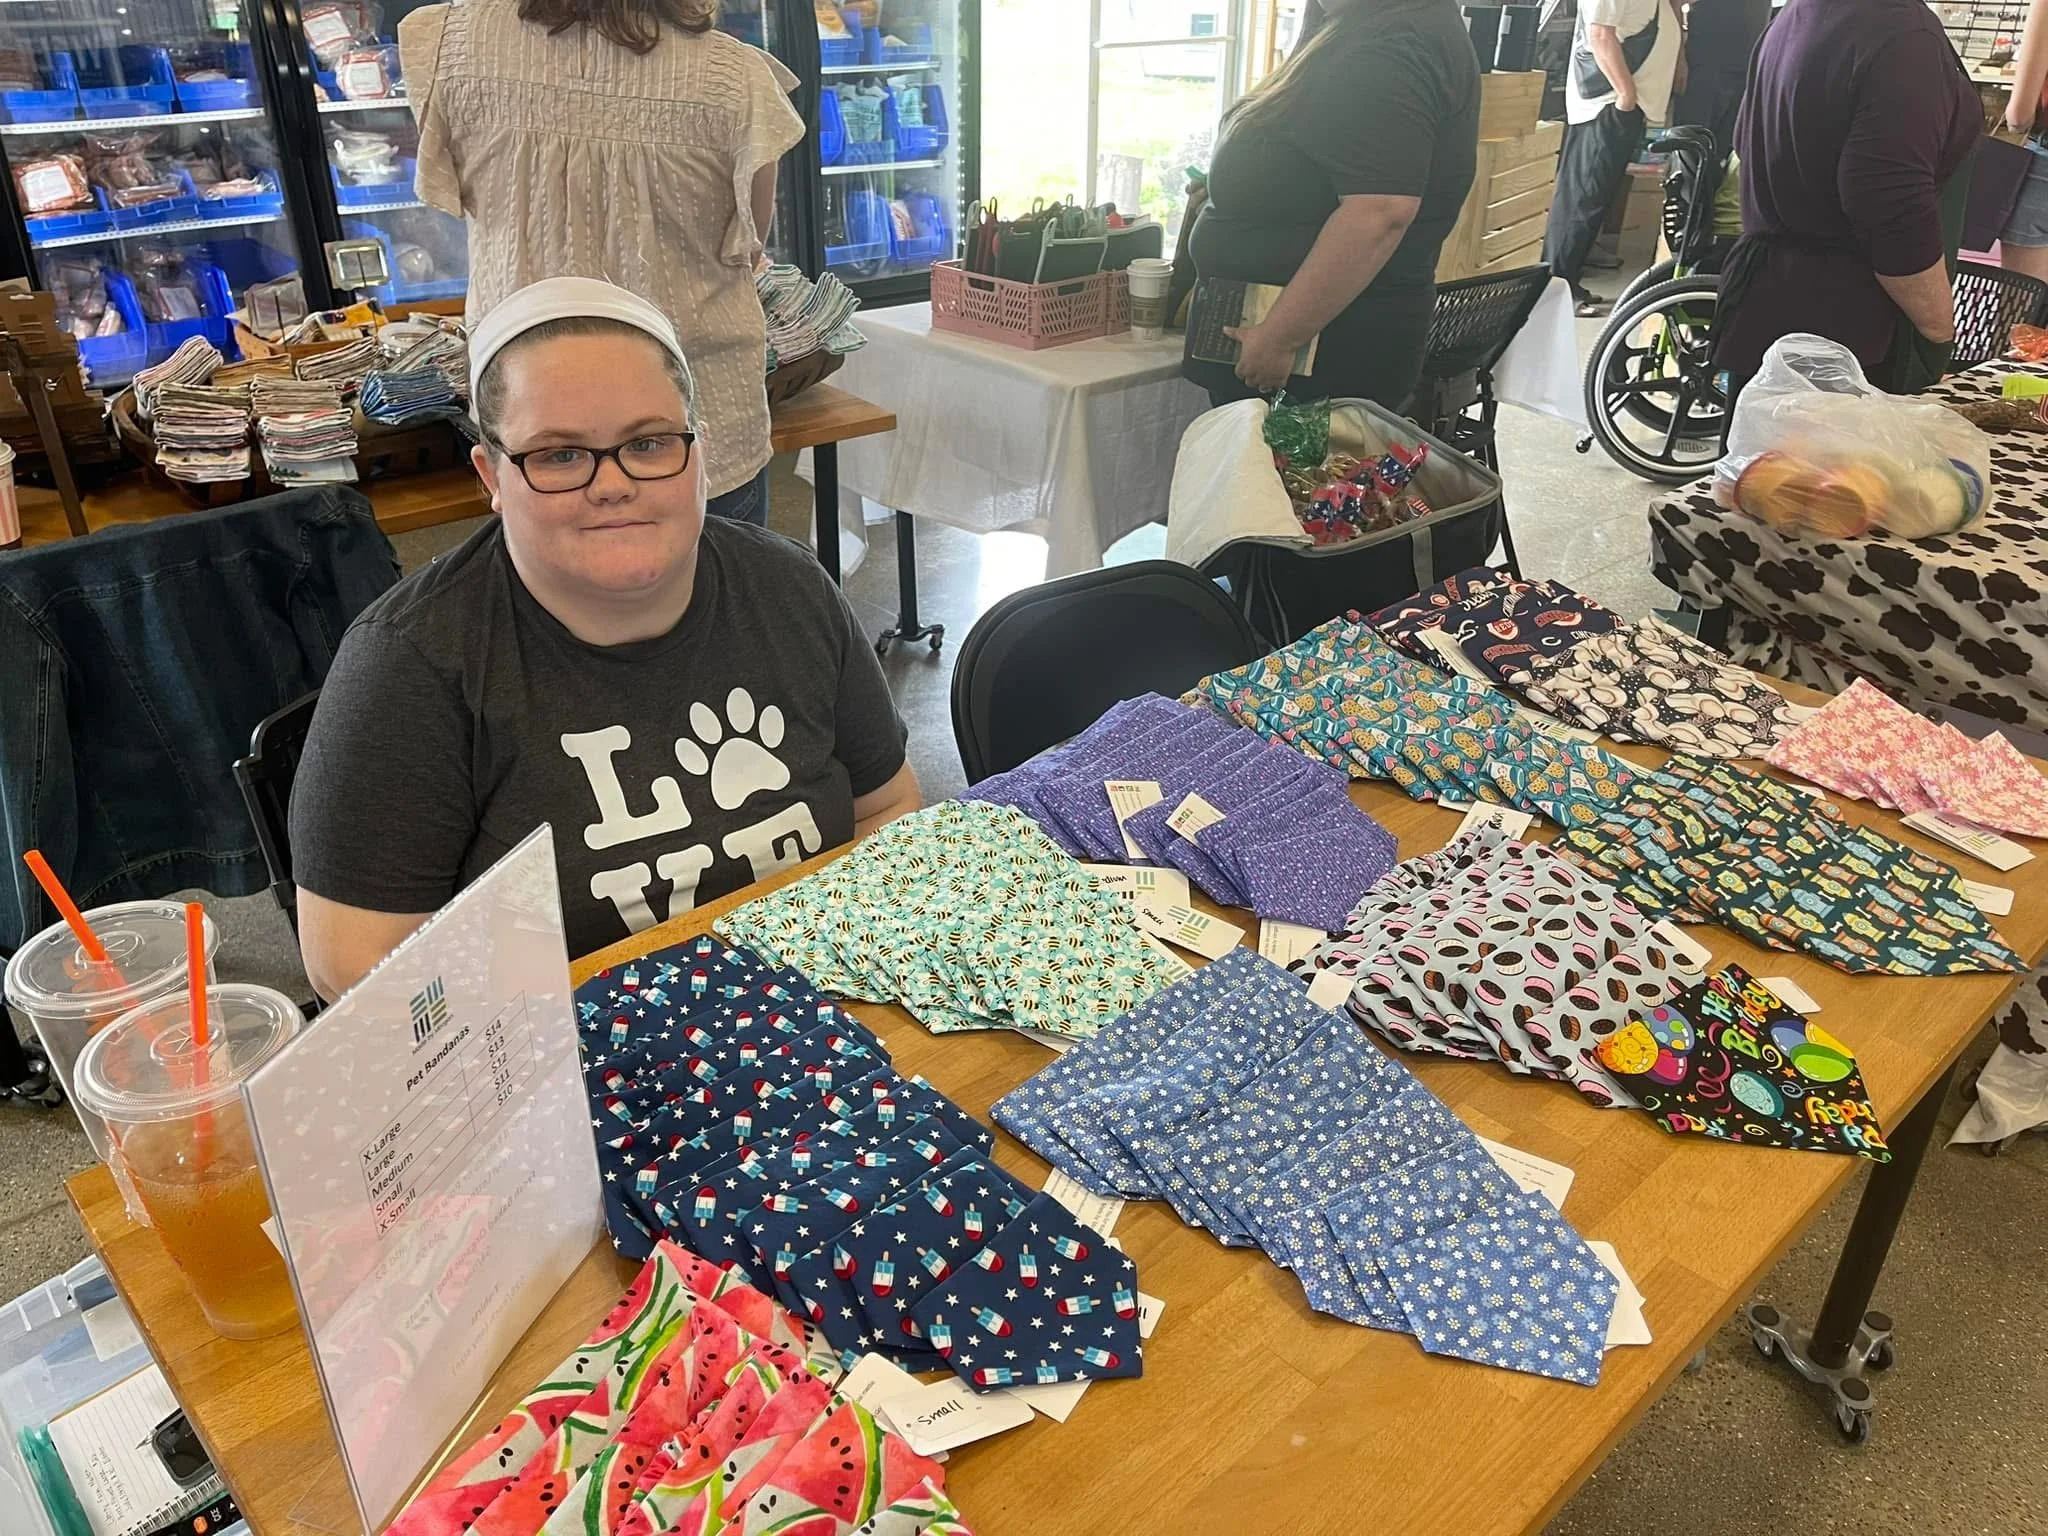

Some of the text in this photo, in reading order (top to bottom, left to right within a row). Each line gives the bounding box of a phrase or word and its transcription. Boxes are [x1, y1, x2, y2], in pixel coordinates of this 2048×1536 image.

[362, 1019, 502, 1164] X-Large $14
[367, 1035, 505, 1182] Large $13
[371, 1151, 414, 1200] Medium
[491, 1051, 508, 1074] $12
[406, 1025, 470, 1092] Pet Bandanas
[375, 1068, 511, 1217] Small $11
[378, 1187, 417, 1234] X-Small
[497, 1084, 513, 1106] $10
[917, 1399, 965, 1426] Small
